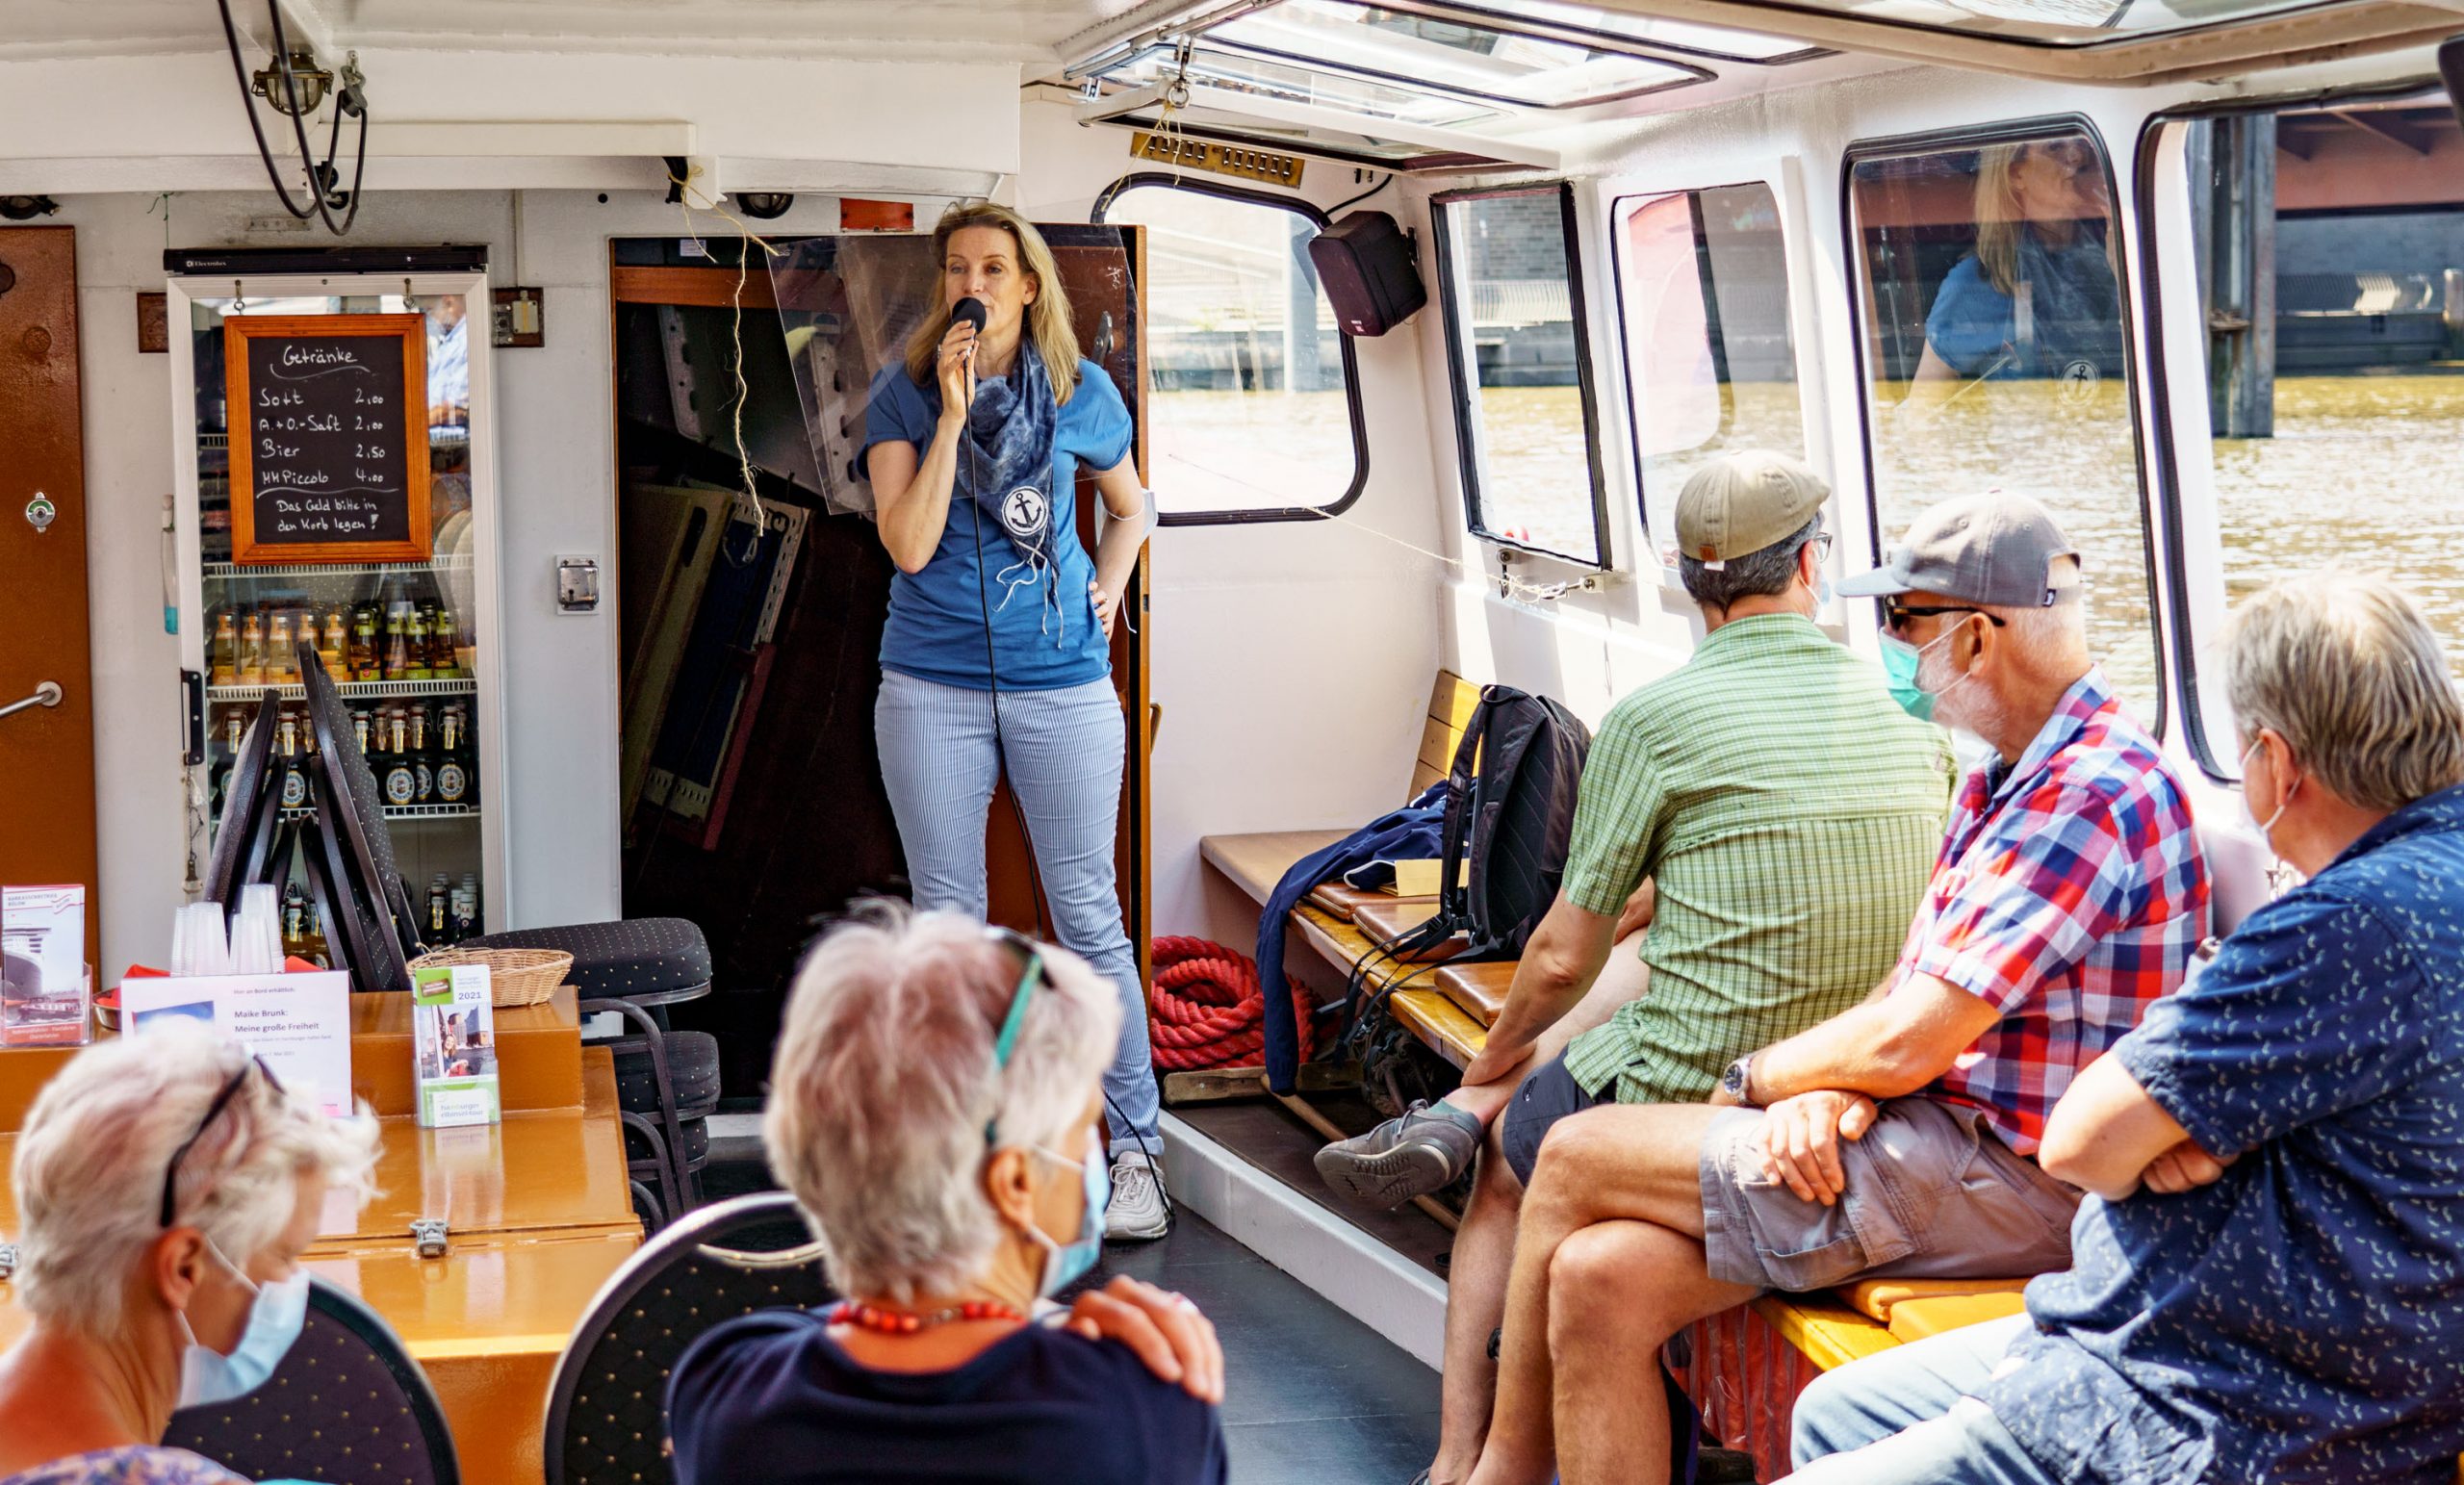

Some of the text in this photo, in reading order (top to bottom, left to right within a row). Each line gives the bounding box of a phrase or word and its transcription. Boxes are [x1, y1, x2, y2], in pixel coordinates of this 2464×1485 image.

[283, 345, 358, 367] Getränke
[261, 438, 300, 458] Bier
[276, 498, 377, 512] Das Geld bitte in
[277, 520, 296, 532] den
[300, 517, 329, 530] Korb
[458, 991, 482, 1001] 2021
[234, 1009, 289, 1018] Maike Brunk:
[235, 1022, 320, 1034] Meine große Freiheit
